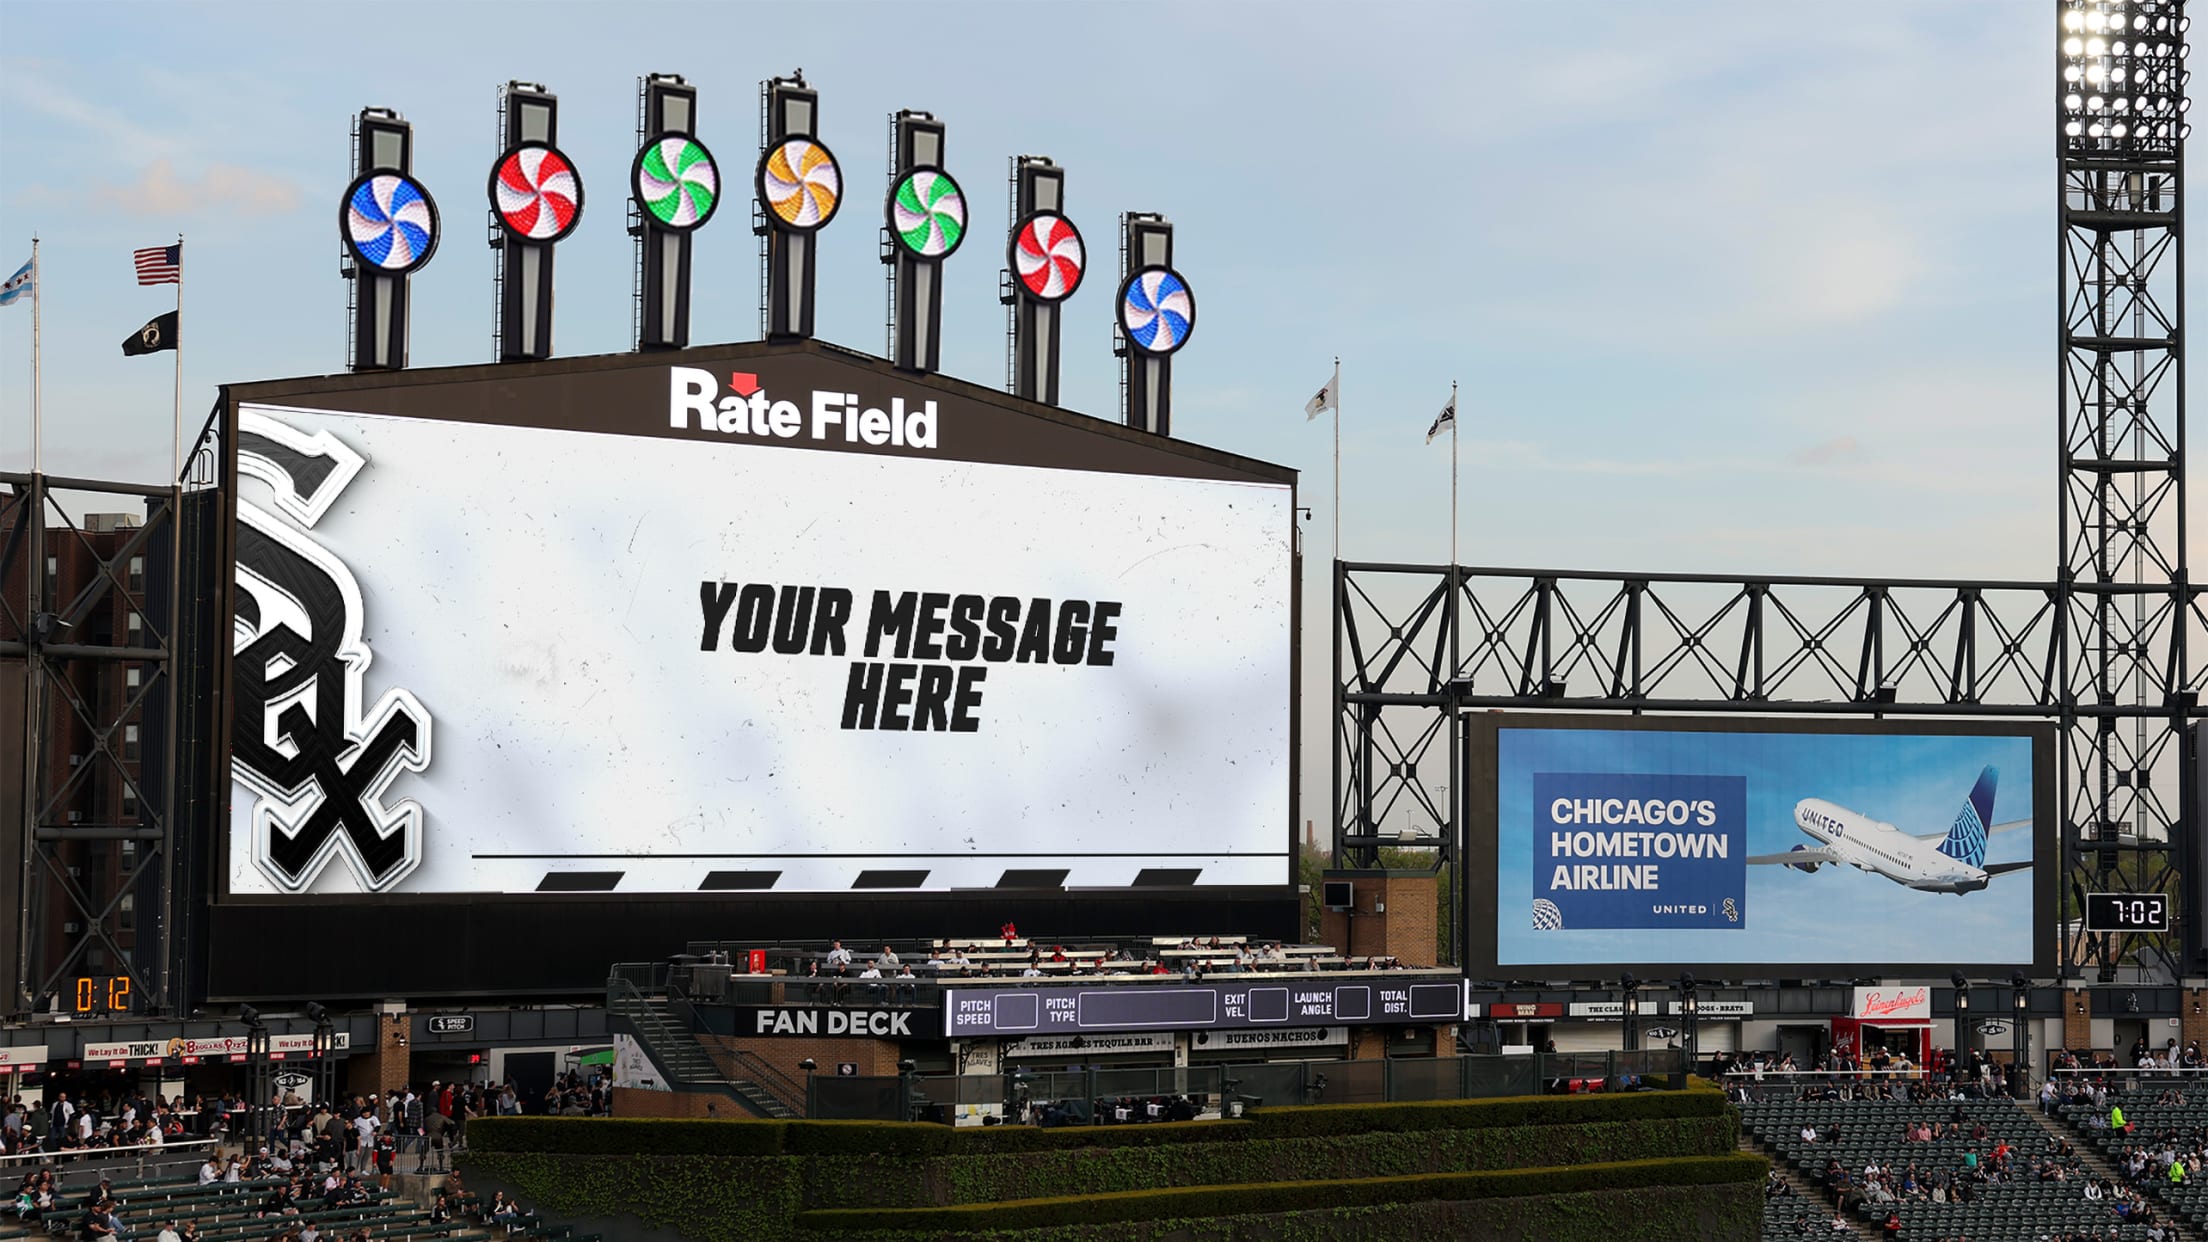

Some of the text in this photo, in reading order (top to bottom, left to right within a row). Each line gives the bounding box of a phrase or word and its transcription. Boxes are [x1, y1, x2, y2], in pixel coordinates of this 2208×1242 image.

[670, 366, 938, 448] Rate Field
[700, 581, 1122, 666] YOUR MESSAGE
[841, 662, 988, 732] HERE
[1551, 798, 1716, 826] CHICAGO'S
[1802, 808, 1845, 838] UNITED
[1551, 832, 1728, 858] HOMETOWN
[1550, 865, 1659, 890] AIRLINE
[1652, 905, 1707, 914] UNITED
[2111, 901, 2162, 924] 7:02
[77, 976, 130, 1012] 0:12
[1224, 994, 1246, 1005] EXIT
[1294, 992, 1332, 1003] LAUNCH
[1380, 990, 1408, 1001] TOTAL
[960, 1000, 991, 1012] PITCH
[1046, 998, 1076, 1010] PITCH
[1301, 1004, 1332, 1016] ANGLE
[1384, 1002, 1408, 1013] DIST.
[756, 1010, 912, 1036] FAN DECK
[956, 1013, 991, 1025] SPEED
[1050, 1011, 1076, 1022] TYPE
[1030, 1041, 1054, 1050] TRES
[1093, 1038, 1132, 1048] TEQUILA
[1134, 1037, 1153, 1046] BAR
[1226, 1031, 1316, 1044] BUENOS NACHOS
[88, 1048, 99, 1056] We
[100, 1048, 112, 1057] Lay
[119, 1047, 128, 1055] On
[128, 1043, 158, 1056] THICK!
[290, 1040, 302, 1049] Lay
